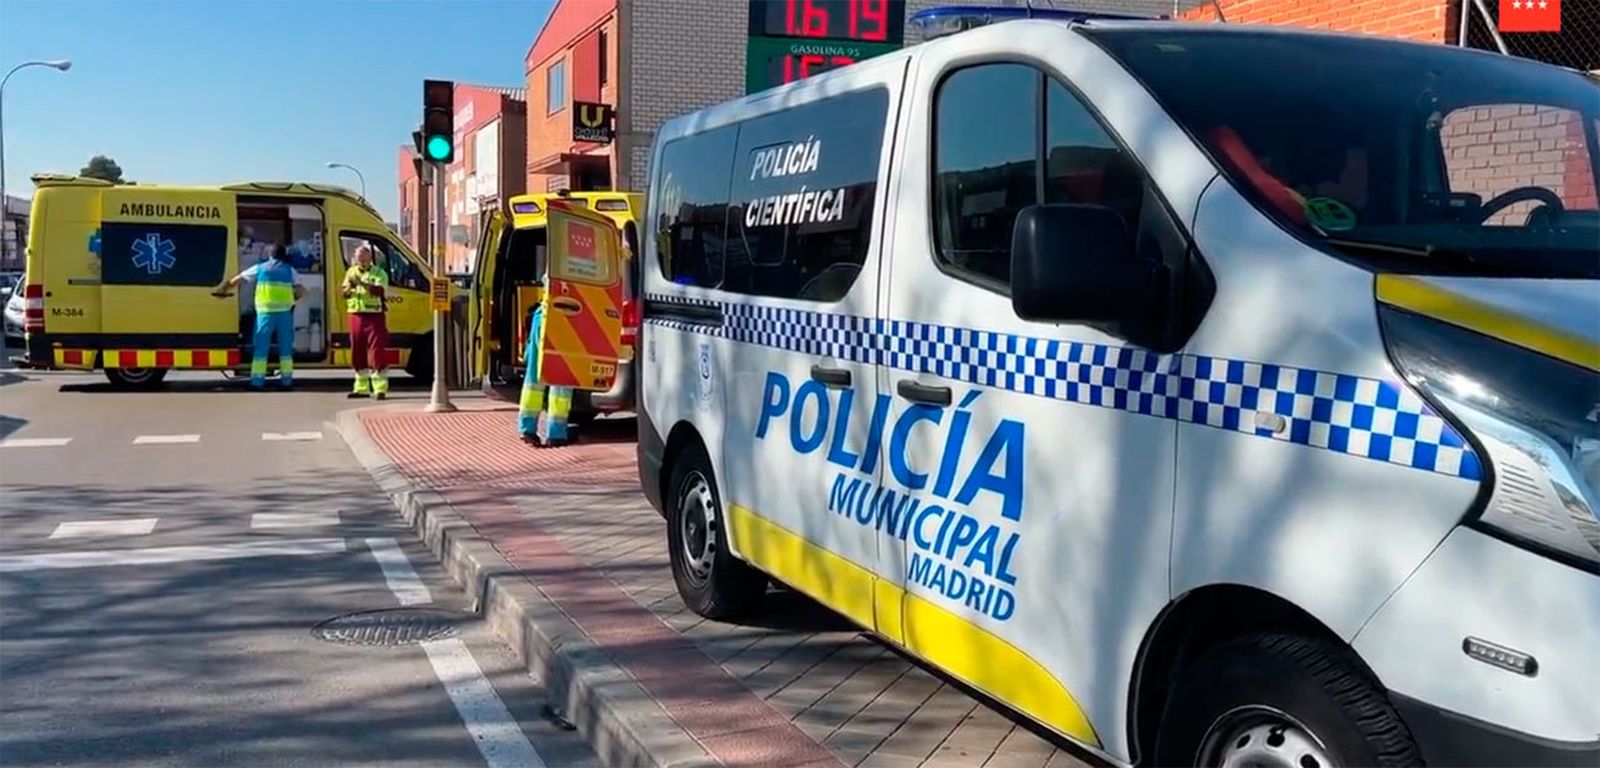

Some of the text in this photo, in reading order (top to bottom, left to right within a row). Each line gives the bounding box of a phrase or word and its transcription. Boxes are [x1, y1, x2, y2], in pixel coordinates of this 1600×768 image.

[790, 44, 860, 57] GASOLINA 95
[750, 135, 821, 181] POLICÍA
[119, 202, 221, 220] AMBULANCIA
[745, 186, 845, 228] CIENTÍFICA
[756, 371, 1025, 522] POLICÍA
[829, 473, 1021, 586] MUNICIPAL
[908, 554, 1016, 622] MADRID
